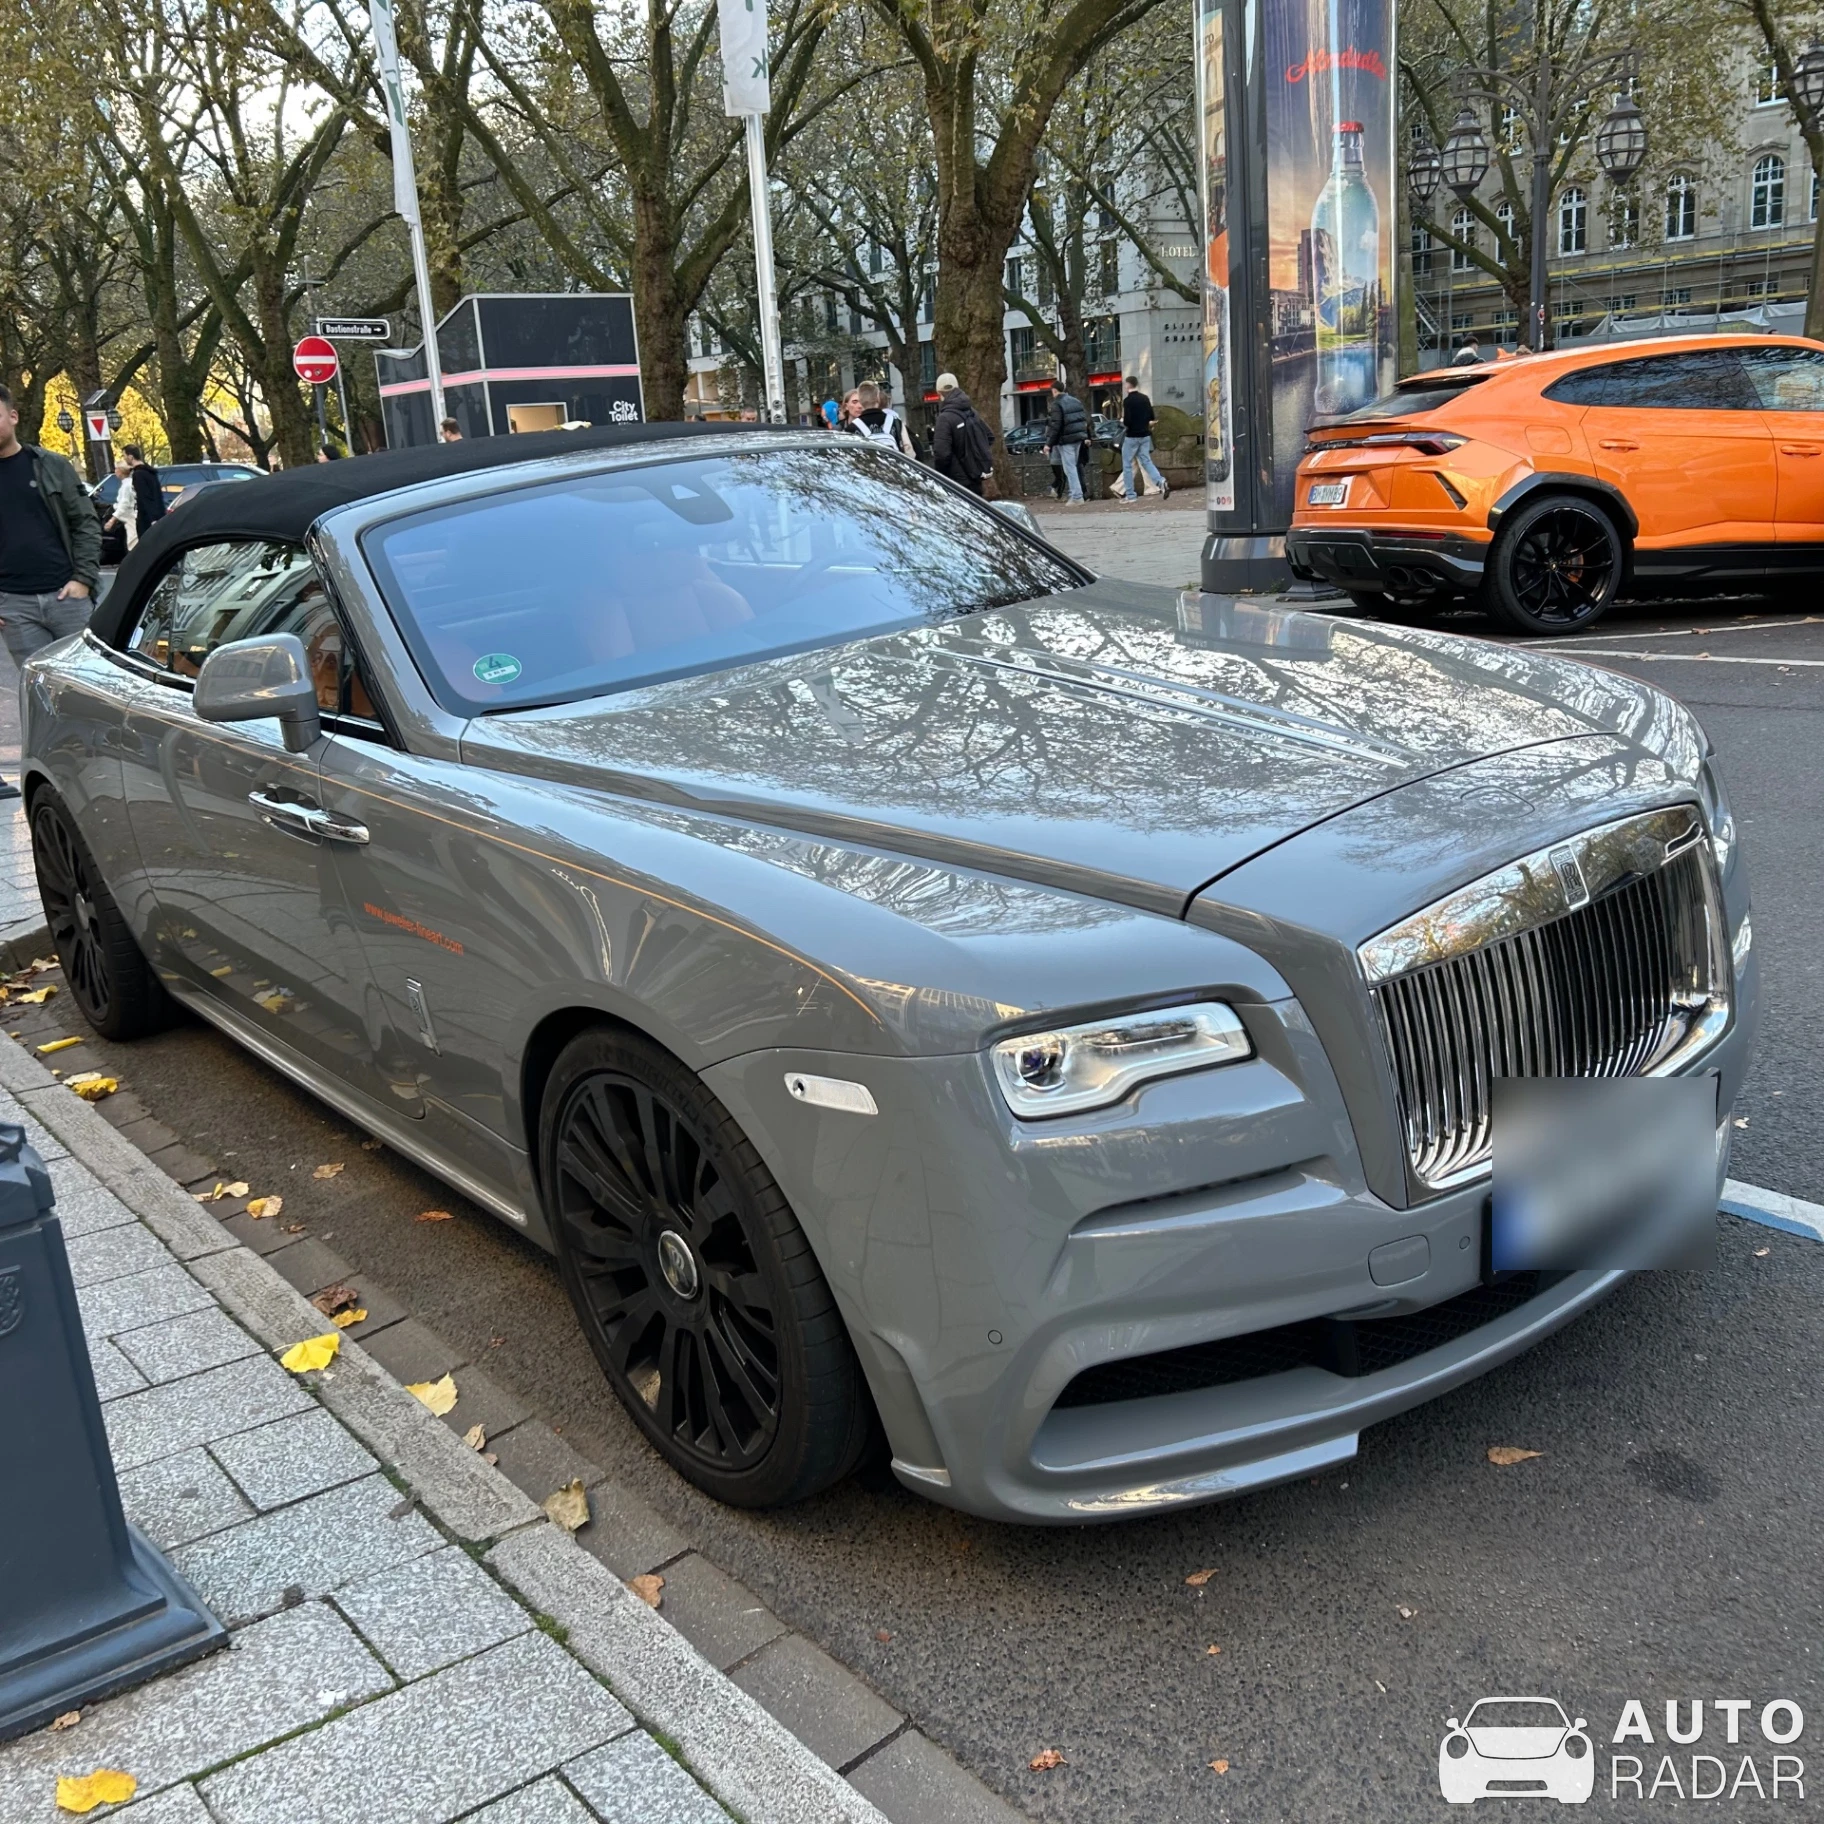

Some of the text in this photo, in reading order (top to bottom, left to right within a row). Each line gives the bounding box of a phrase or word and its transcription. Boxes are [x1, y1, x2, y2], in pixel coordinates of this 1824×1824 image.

[325, 324, 372, 334] Bastionstraße
[613, 400, 635, 413] City
[609, 411, 638, 422] Toilet
